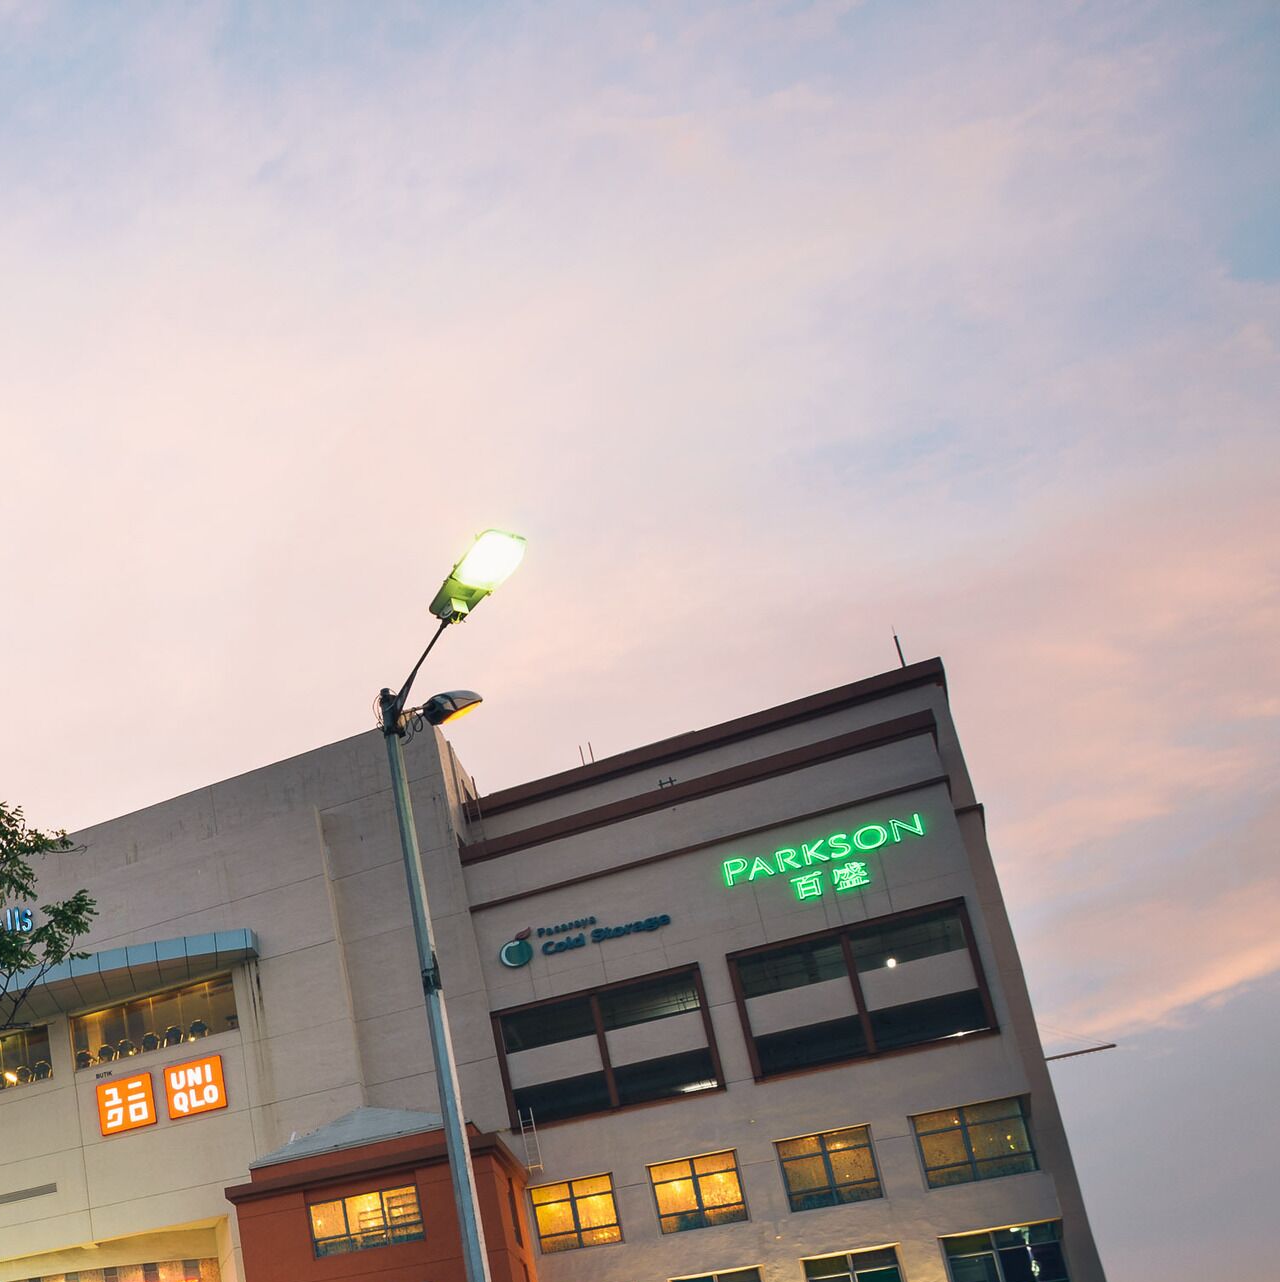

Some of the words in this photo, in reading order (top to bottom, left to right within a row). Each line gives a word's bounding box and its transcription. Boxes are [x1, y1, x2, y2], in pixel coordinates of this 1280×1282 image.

[723, 813, 925, 887] PARKSON
[790, 861, 871, 900] 百盛
[542, 933, 586, 955] Cold
[591, 914, 671, 943] Storage
